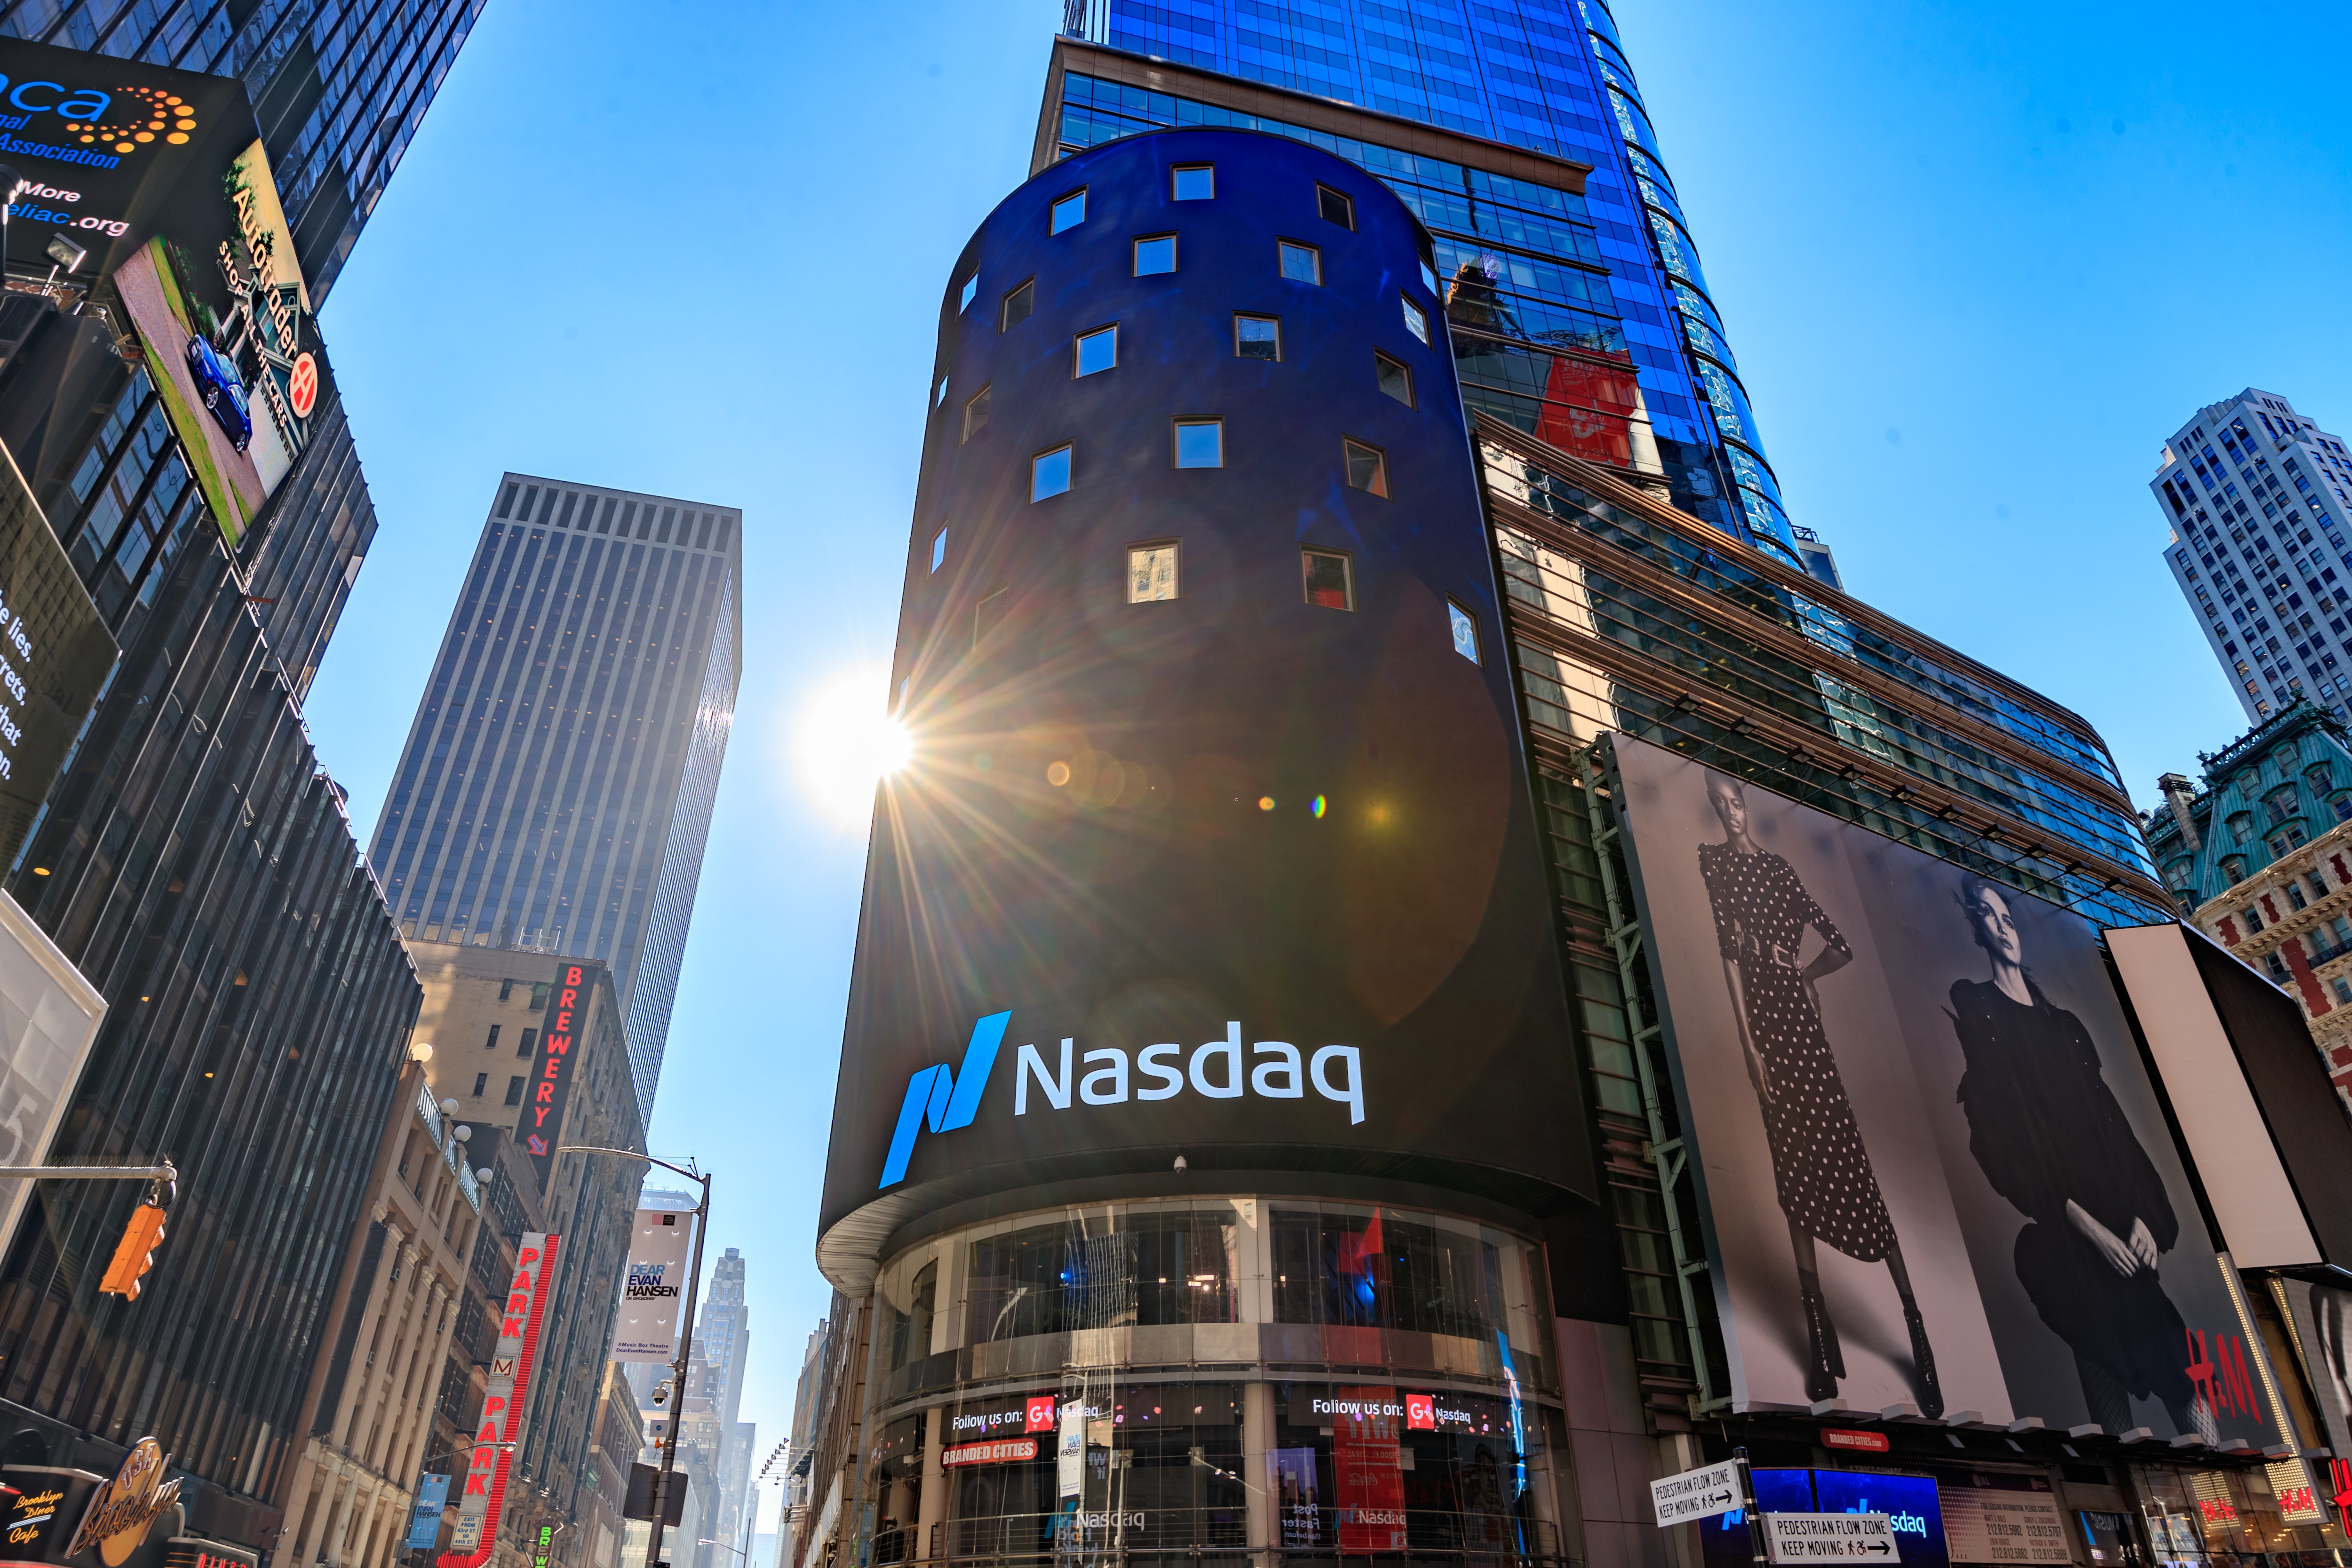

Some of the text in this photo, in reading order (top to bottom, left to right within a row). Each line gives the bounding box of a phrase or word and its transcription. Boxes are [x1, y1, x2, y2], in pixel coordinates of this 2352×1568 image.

[0, 73, 111, 122] ca
[19, 181, 81, 202] More
[233, 188, 298, 359] Autotrader
[219, 240, 287, 428] SHOP ALL THE CARS
[8, 616, 32, 662] lies.
[0, 654, 27, 706] rets.
[535, 966, 582, 1127] BREWERY
[1014, 1021, 1366, 1125] Nasdaq
[628, 1275, 662, 1286] EVAN
[630, 1265, 666, 1275] DEAR
[501, 1247, 539, 1337] PARK
[626, 1286, 679, 1297] HANSEN
[2185, 1327, 2263, 1426] H&M
[953, 1414, 986, 1430] Follow
[989, 1413, 1002, 1425] us
[1004, 1411, 1023, 1423] on:
[1313, 1399, 1360, 1414] Follow
[1364, 1404, 1380, 1415] us
[1383, 1404, 1404, 1417] on:
[1436, 1408, 1471, 1424] Nasdaq
[466, 1397, 505, 1495] PARK
[1829, 1433, 1855, 1445] BRANDED
[942, 1442, 1034, 1465] BRANDED CITIES
[121, 1443, 156, 1490] USA
[1655, 1469, 1730, 1501] PEDESTRIAN FLOW ZONE
[13, 1490, 64, 1509] Brooklyn
[24, 1504, 56, 1519] Diner
[64, 1453, 184, 1559] Brooklyn
[1659, 1496, 1700, 1519] KEEP MOVING
[9, 1525, 39, 1544] Cafe
[1777, 1520, 1887, 1535] PEDESTRIAN FLOW ZONE
[2026, 1525, 2061, 1537] 212.812.5707
[535, 1526, 552, 1568] BREW
[1781, 1541, 1843, 1556] KEEP MOVING
